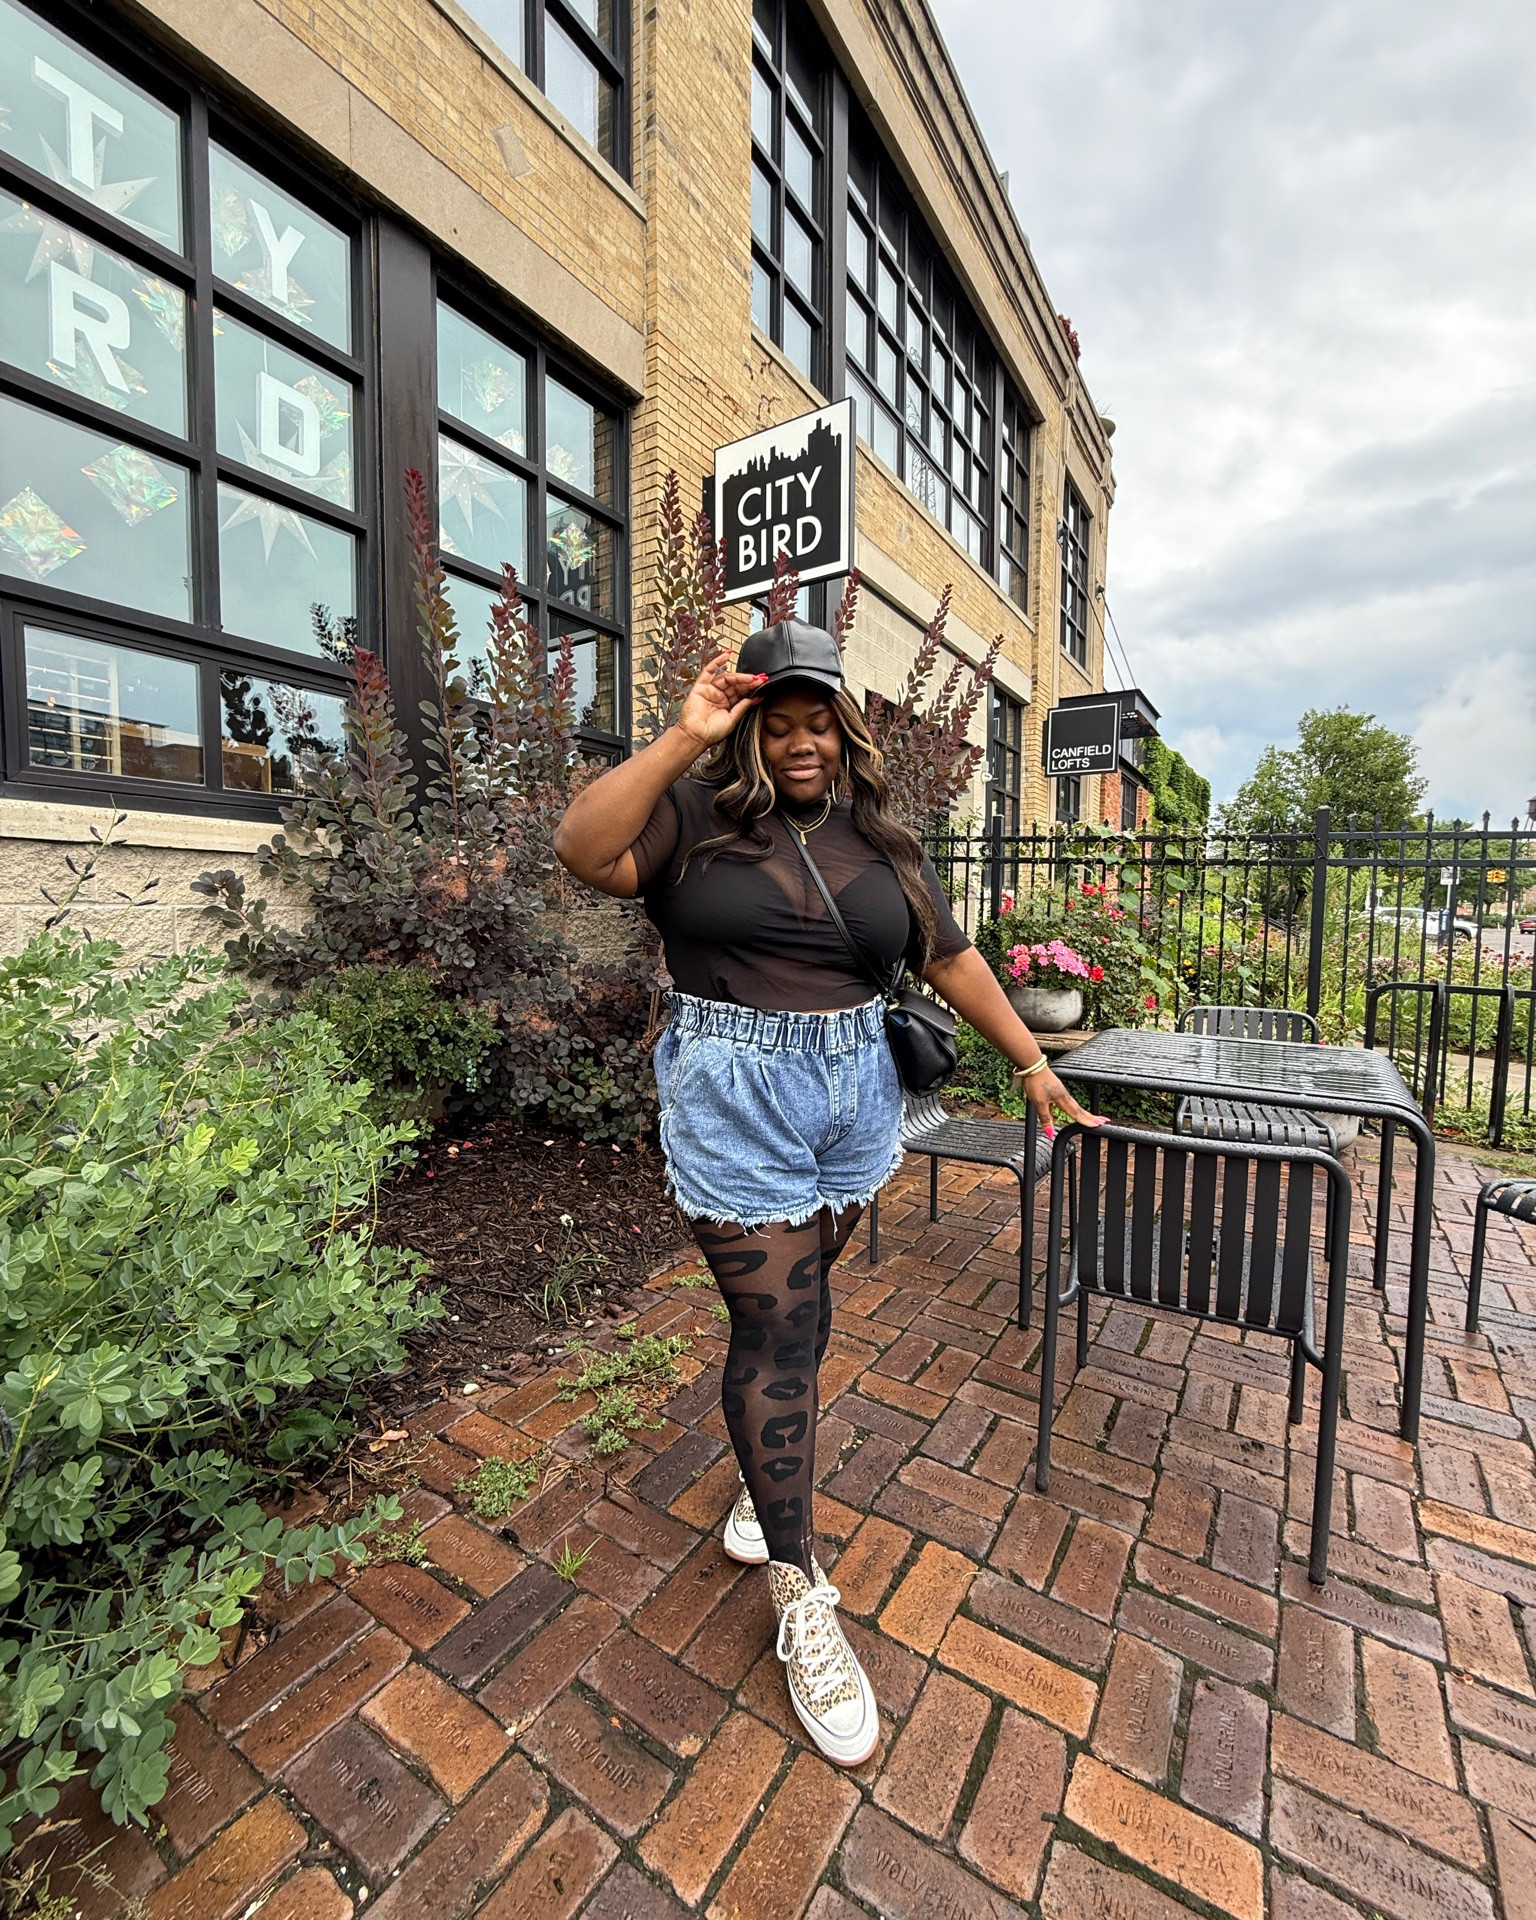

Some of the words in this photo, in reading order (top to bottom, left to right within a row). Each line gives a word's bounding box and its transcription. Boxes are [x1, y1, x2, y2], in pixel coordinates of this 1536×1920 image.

[737, 465, 823, 526] CITY
[738, 515, 823, 573] BIRD
[1051, 744, 1112, 759] CANFIELD
[1051, 758, 1090, 770] LOFTS
[1159, 1563, 1251, 1609] WOLVERINE
[1146, 1610, 1241, 1661] WOLVERINE
